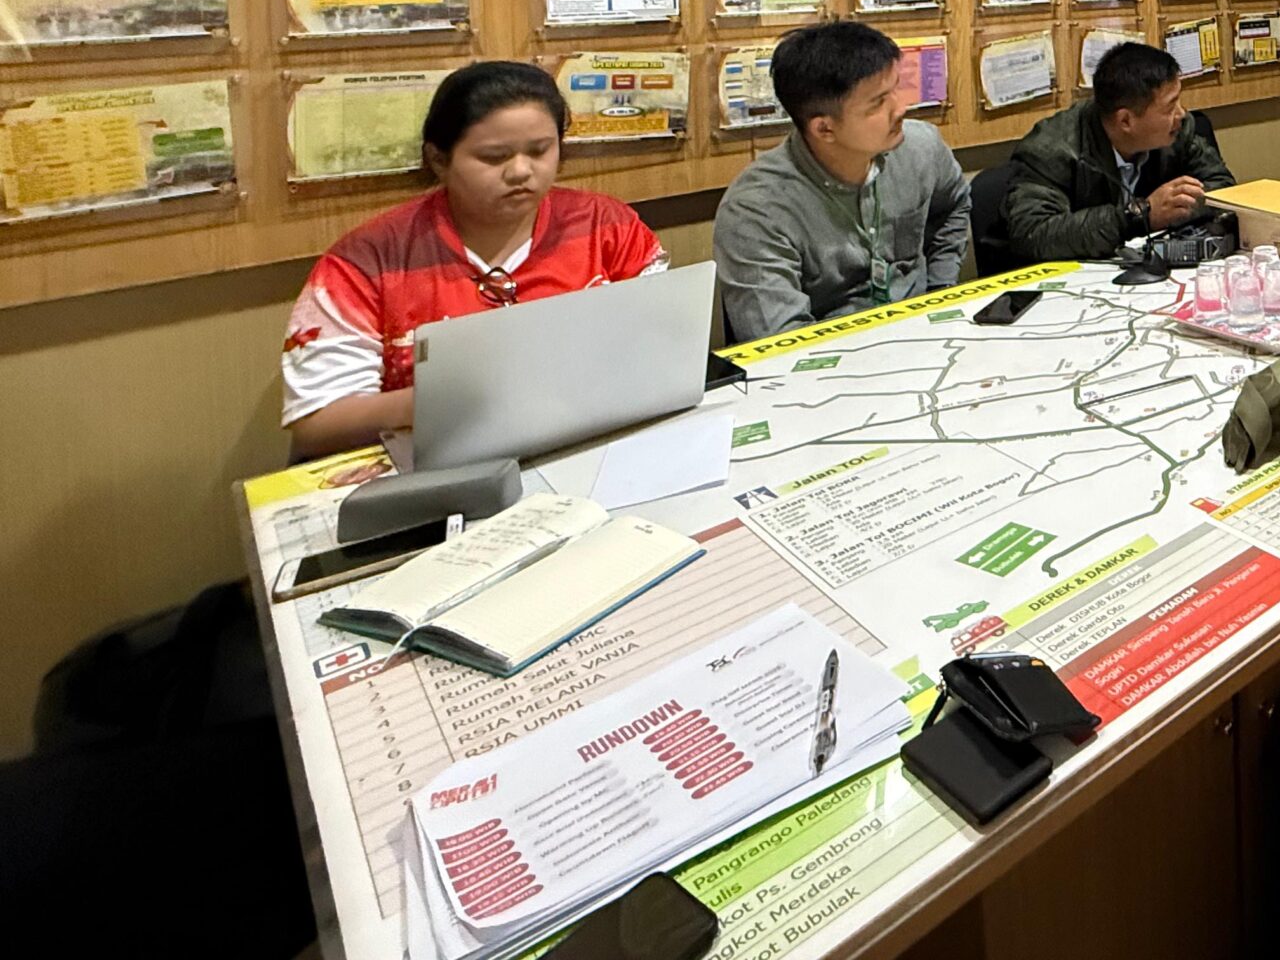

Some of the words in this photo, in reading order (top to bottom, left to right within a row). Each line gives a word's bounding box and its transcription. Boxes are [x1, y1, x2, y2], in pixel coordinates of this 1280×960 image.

[753, 309, 900, 354] POLRESTA
[905, 282, 995, 311] BOGOR
[998, 267, 1060, 286] KOTA
[792, 468, 838, 490] Jalan
[838, 453, 876, 471] TOL
[773, 497, 806, 513] Jalan
[801, 518, 834, 535] Jalan
[856, 487, 908, 512] Jagorawi
[830, 542, 865, 559] Jalan
[886, 510, 933, 533] BOCIMI
[959, 488, 984, 502] Kota
[984, 472, 1021, 490] Bogor)
[1028, 583, 1075, 613] DEREK
[1075, 576, 1089, 588] &
[1087, 547, 1139, 580] DAMKAR
[1036, 623, 1067, 644] Derek
[1068, 598, 1107, 623] DISHUB
[1106, 586, 1129, 603] Kota
[1126, 572, 1152, 591] Bogor
[1148, 587, 1200, 621] PEMADAM
[1047, 631, 1079, 653] Derek
[1078, 614, 1107, 636] Garda
[1106, 603, 1125, 618] Oto
[1059, 641, 1092, 662] Derek
[1091, 616, 1128, 643] TEPLAN
[446, 682, 517, 716] Rumah
[522, 660, 569, 685] Sakit
[575, 629, 636, 659] Juliana
[452, 695, 524, 730] Rumah
[530, 670, 577, 693] Sakit
[581, 642, 640, 670] VANIA
[1084, 648, 1129, 680] DAMKAR
[1107, 672, 1139, 697] UPTD
[1139, 650, 1175, 676] Damkar
[1121, 674, 1166, 706] DAMKAR
[1165, 646, 1206, 676] Abdullah
[457, 716, 512, 745] RSIA
[516, 674, 606, 718] MELANIA
[464, 731, 519, 759] RSIA
[524, 700, 584, 731] UMMI
[577, 699, 684, 763] RUNDOWN
[692, 824, 793, 891] Pangrango
[795, 774, 871, 827] Paledang
[755, 883, 786, 903] Ps.
[790, 817, 883, 882] Gembrong
[769, 863, 853, 923] Merdeka
[783, 886, 861, 943] Bubulak
